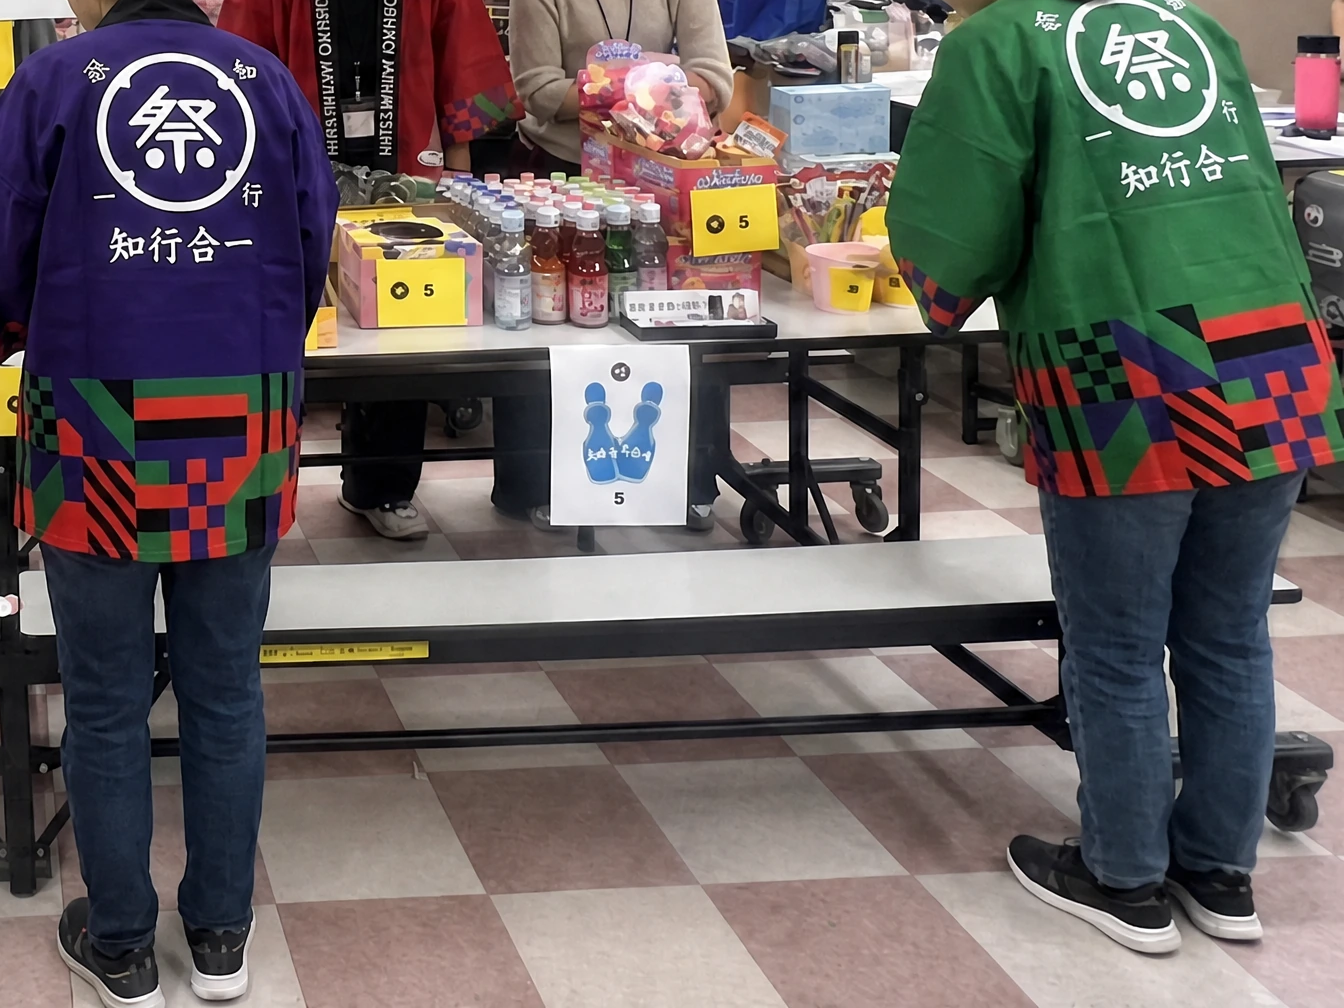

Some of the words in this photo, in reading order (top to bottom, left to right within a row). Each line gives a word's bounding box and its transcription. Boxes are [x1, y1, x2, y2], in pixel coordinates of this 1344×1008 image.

[1099, 23, 1192, 101] 祭
[128, 84, 223, 175] 祭
[1120, 144, 1250, 198] 知行合一
[739, 215, 750, 229] 5
[109, 225, 253, 264] 知行合一
[423, 284, 434, 297] 5
[614, 492, 625, 505] 5
